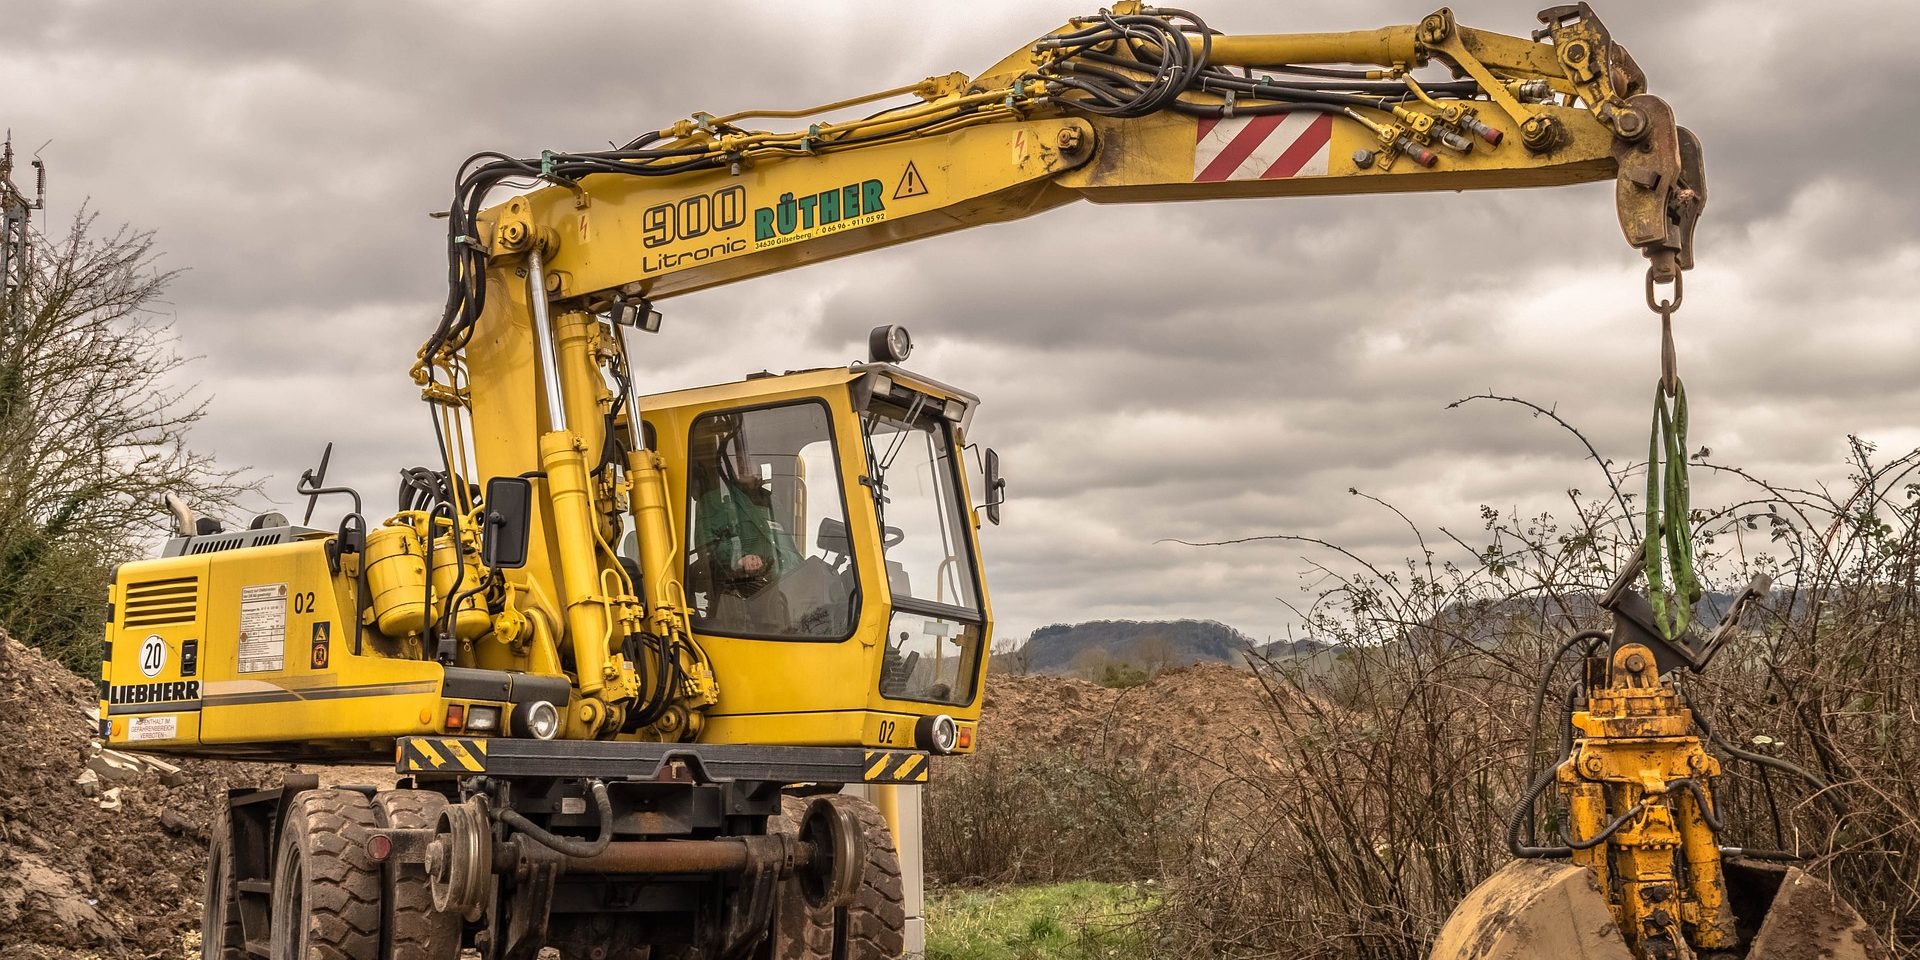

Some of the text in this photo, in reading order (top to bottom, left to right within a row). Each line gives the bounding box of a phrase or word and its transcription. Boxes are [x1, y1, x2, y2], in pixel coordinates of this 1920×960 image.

[643, 185, 746, 249] 900
[755, 179, 885, 241] RÜTHER
[755, 240, 775, 249] 34630
[776, 232, 812, 245] Gilserberg
[643, 237, 746, 273] Litronic
[294, 592, 315, 614] 02
[144, 643, 161, 669] 20
[111, 681, 199, 704] LIEBHERR
[879, 720, 895, 744] 02
